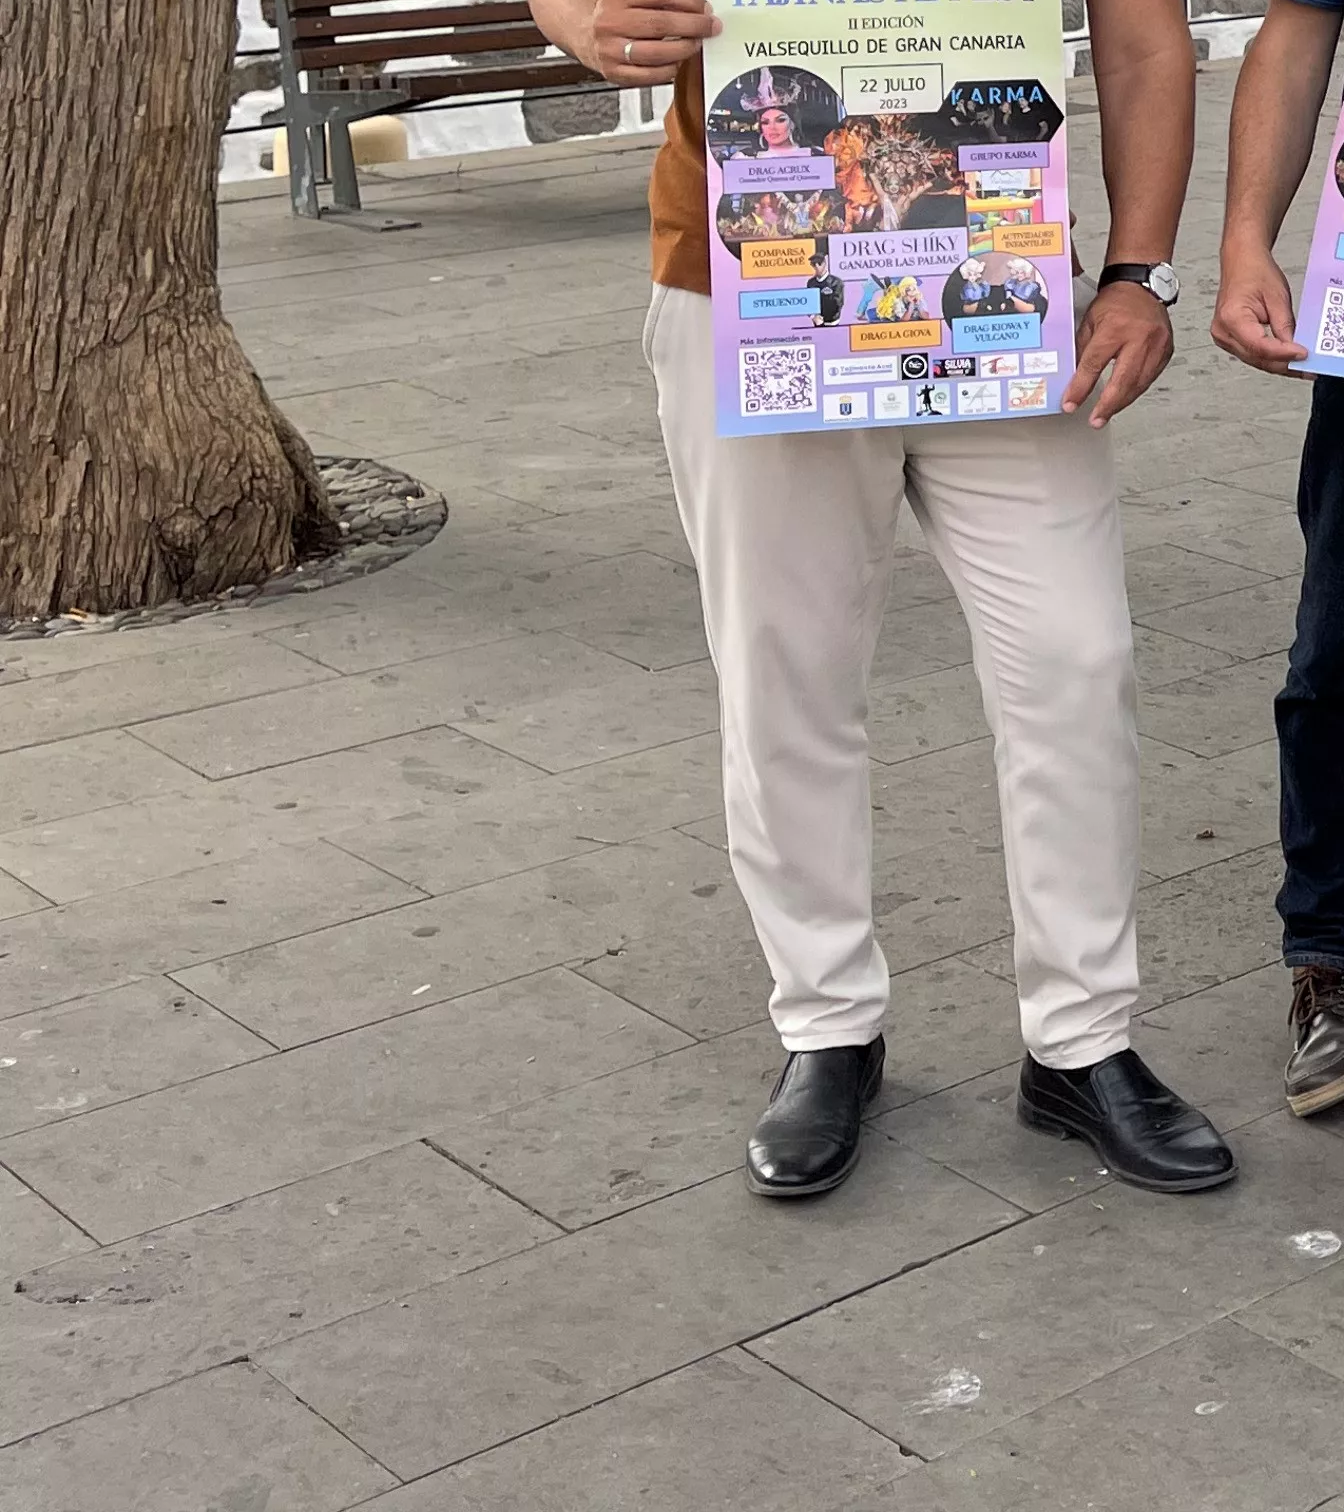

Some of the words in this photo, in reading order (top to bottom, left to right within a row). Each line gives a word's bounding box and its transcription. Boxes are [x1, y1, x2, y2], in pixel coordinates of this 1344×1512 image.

[847, 17, 858, 29] II
[861, 14, 924, 29] EDICIÓN
[745, 39, 858, 57] VALSEQUILLO
[867, 38, 886, 53] DE
[895, 36, 941, 52] GRAN
[949, 34, 1025, 50] CANARIA
[859, 78, 877, 92] 22
[884, 77, 925, 92] JULIO
[950, 85, 1043, 105] KARMA
[879, 97, 907, 109] 2023
[970, 152, 1002, 161] GRUPO
[1005, 150, 1036, 159] KARMA
[748, 166, 775, 175] DRAG
[751, 246, 805, 258] COMPARSA
[843, 238, 895, 257] DRAG
[839, 258, 893, 270] GANADOR
[895, 256, 915, 266] LAS
[917, 254, 959, 265] PALMAS
[753, 296, 807, 307] STRUENDO
[963, 324, 989, 333] DRAG
[860, 331, 886, 341] DRAG
[888, 330, 900, 339] LA
